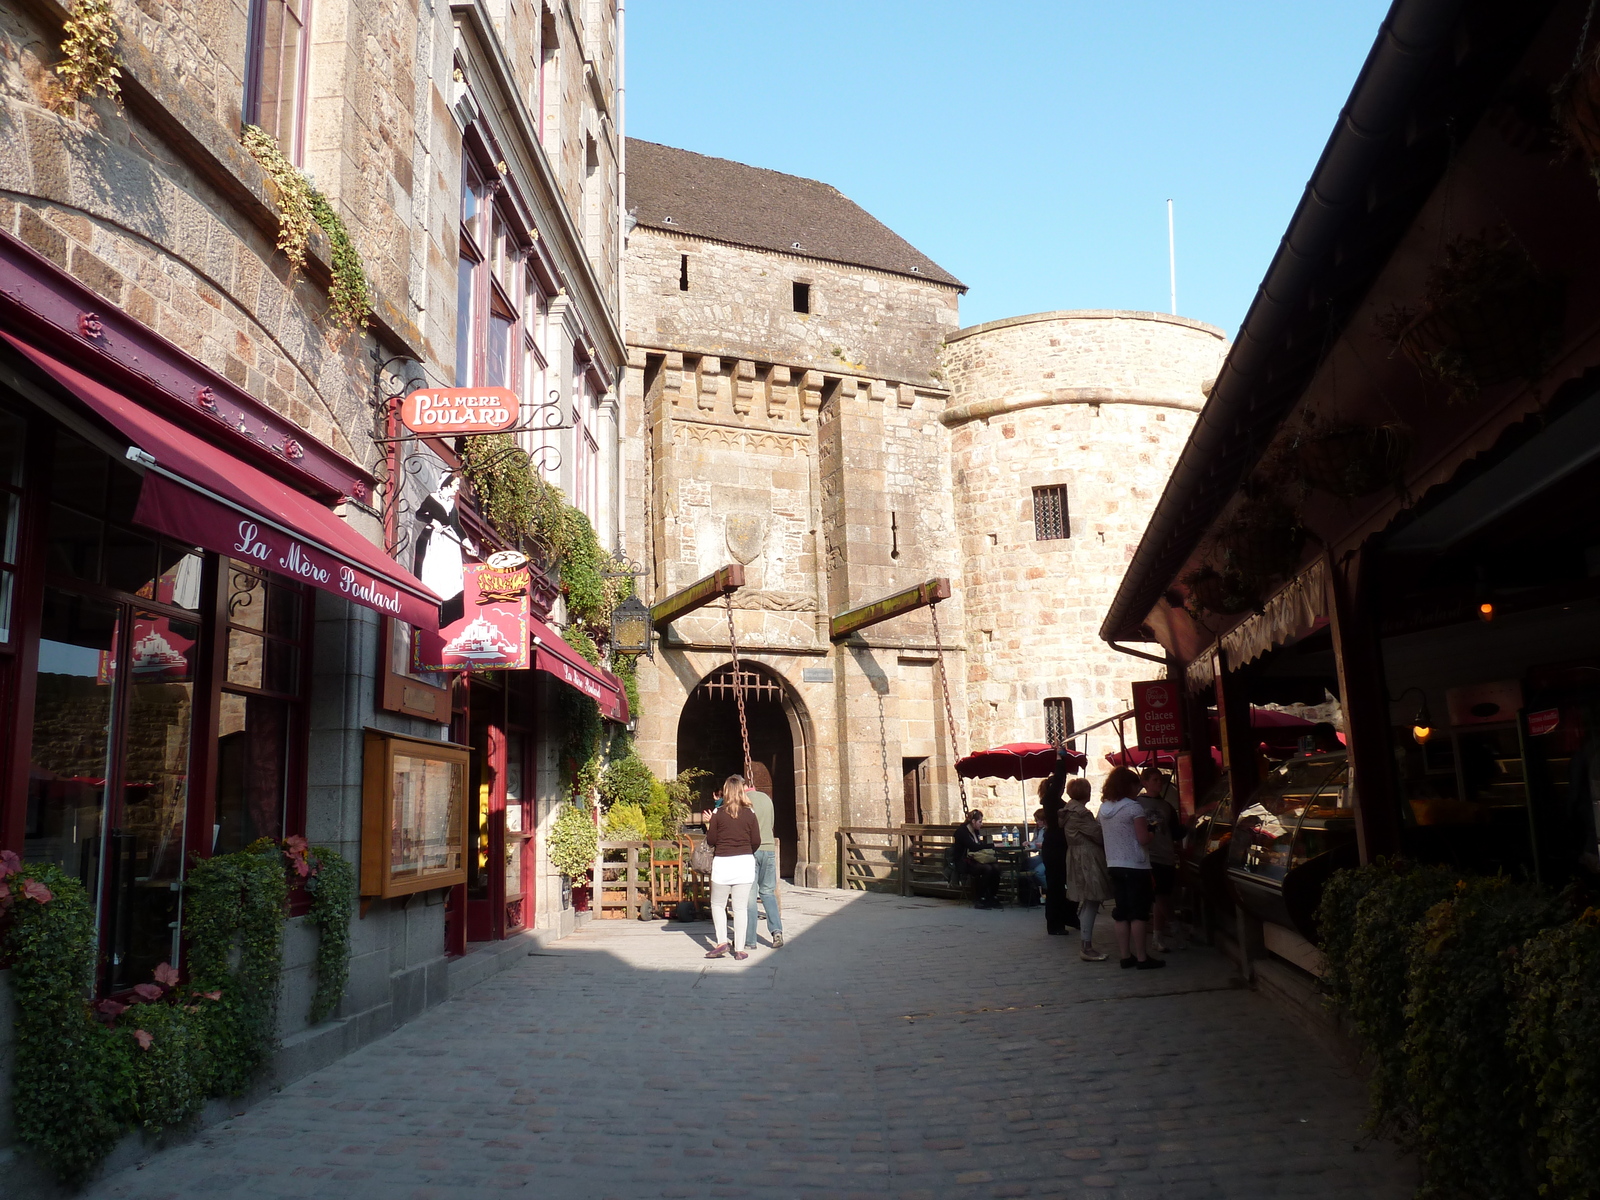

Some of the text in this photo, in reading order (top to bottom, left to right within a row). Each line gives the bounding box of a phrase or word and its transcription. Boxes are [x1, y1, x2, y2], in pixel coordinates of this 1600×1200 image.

[432, 394, 452, 407] LA
[412, 395, 509, 426] POULARD
[234, 520, 402, 614] La Mère Poulard
[1144, 711, 1174, 721] Glaces
[1144, 723, 1176, 734] Crêpes
[1144, 735, 1179, 745] Gaufres
